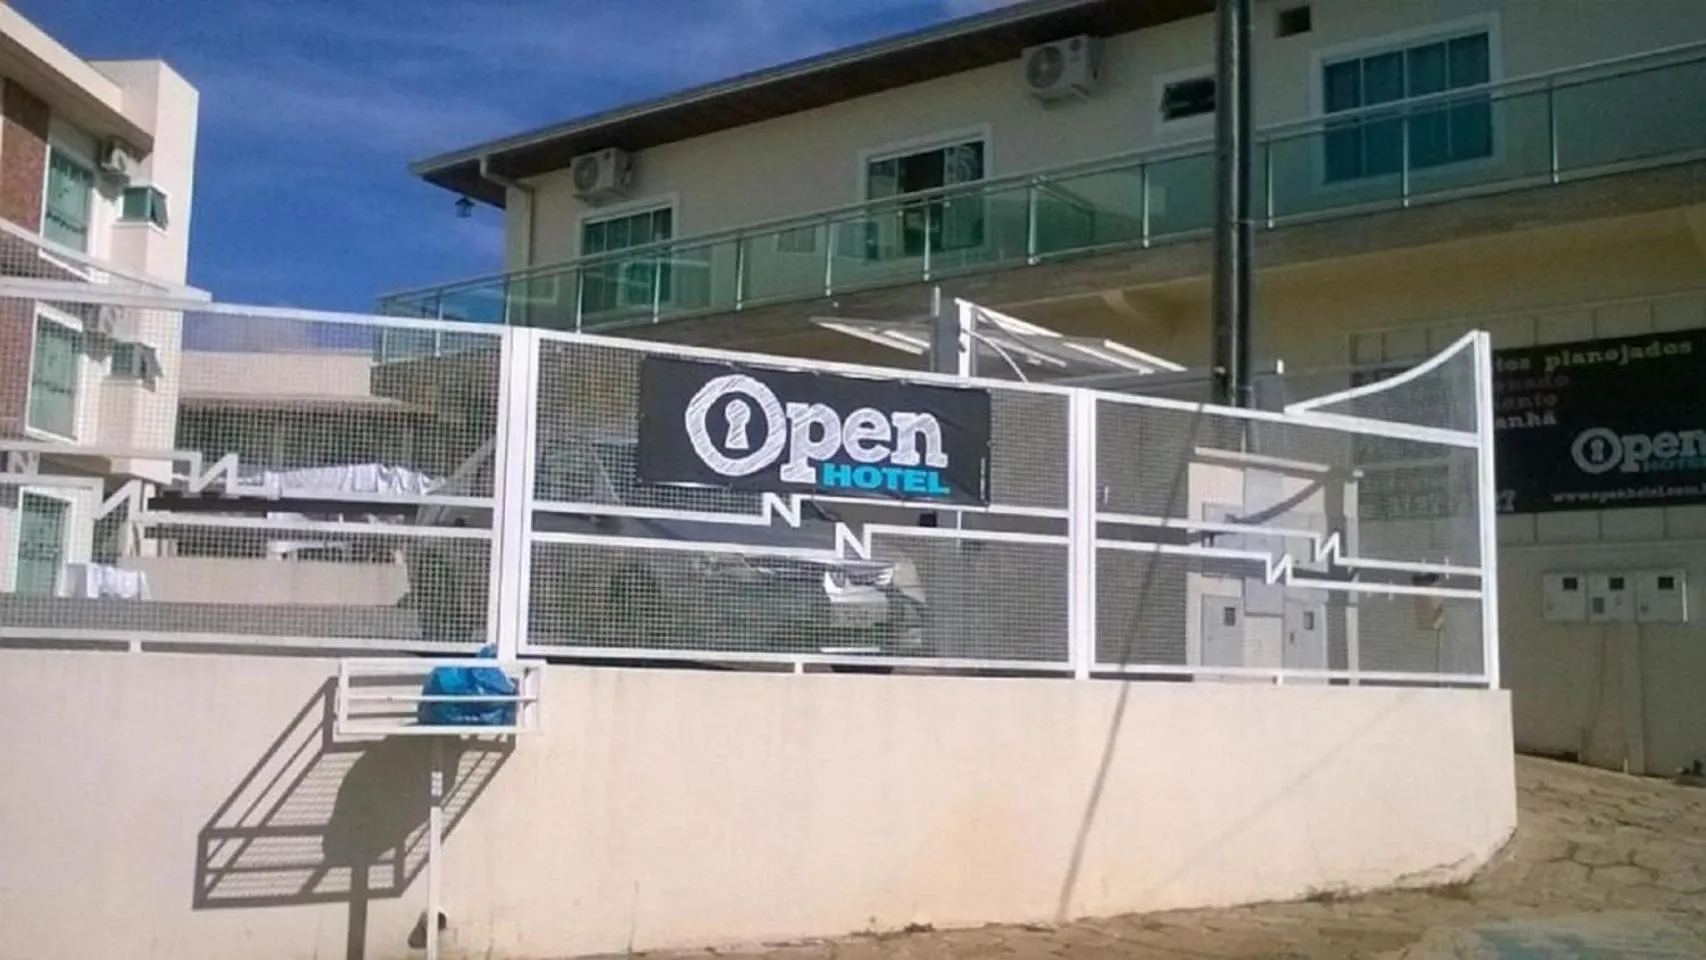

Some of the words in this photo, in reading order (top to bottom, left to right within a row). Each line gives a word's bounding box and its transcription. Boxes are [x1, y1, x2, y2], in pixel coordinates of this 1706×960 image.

[1544, 341, 1692, 372] planejados
[685, 374, 948, 483] Open
[1571, 427, 1706, 474] Open
[821, 462, 950, 494] HOTEL
